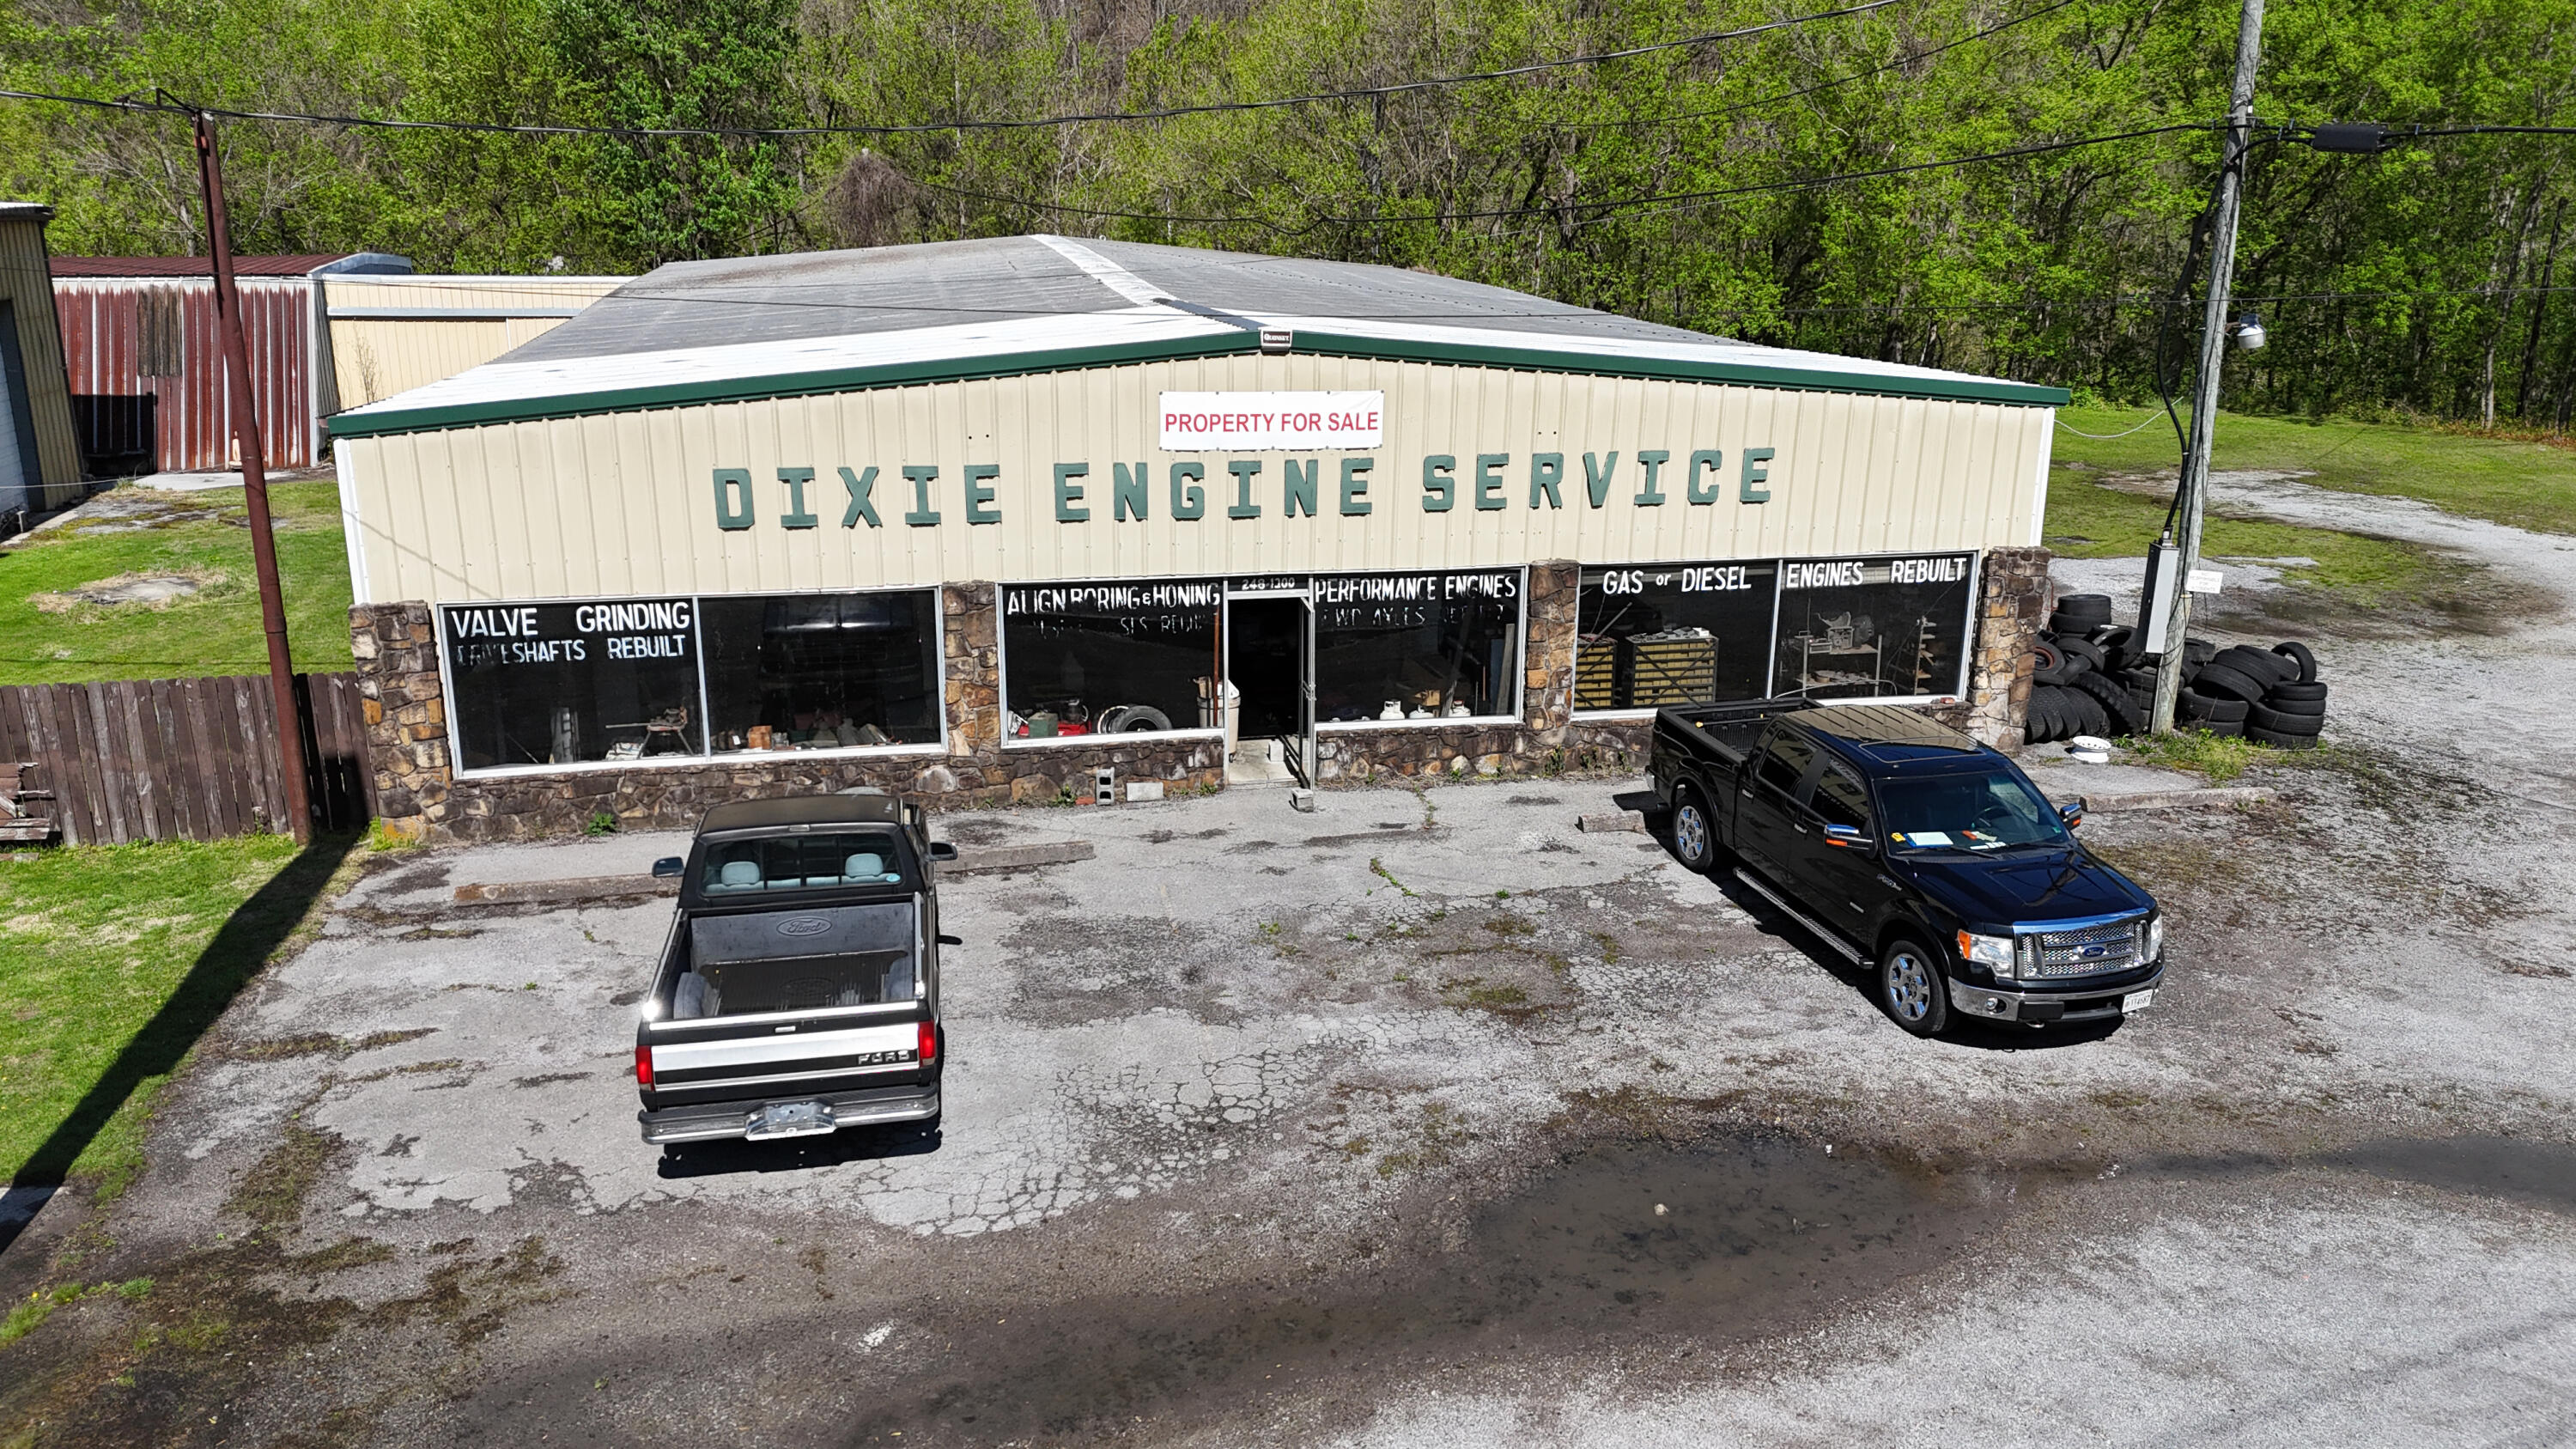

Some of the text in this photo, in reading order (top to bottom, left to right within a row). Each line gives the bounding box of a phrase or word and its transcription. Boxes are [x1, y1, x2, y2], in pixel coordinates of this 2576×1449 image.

[1165, 412, 1378, 432] PROPERTY FOR SALE
[713, 447, 1776, 531] DIXIE ENGINE SERVICE
[1602, 566, 1752, 594] GAS or DIESEL
[1786, 557, 1967, 588] ENGINES REBUILT
[1006, 588, 1066, 616] ALIGN
[1152, 582, 1220, 608] HONING
[1315, 574, 1517, 603] PERFORMANCE ENGINES
[451, 601, 691, 639] VALVE GRINDING
[606, 634, 686, 660] REBUILT
[787, 919, 823, 934] Ford
[859, 1050, 910, 1066] FORD
